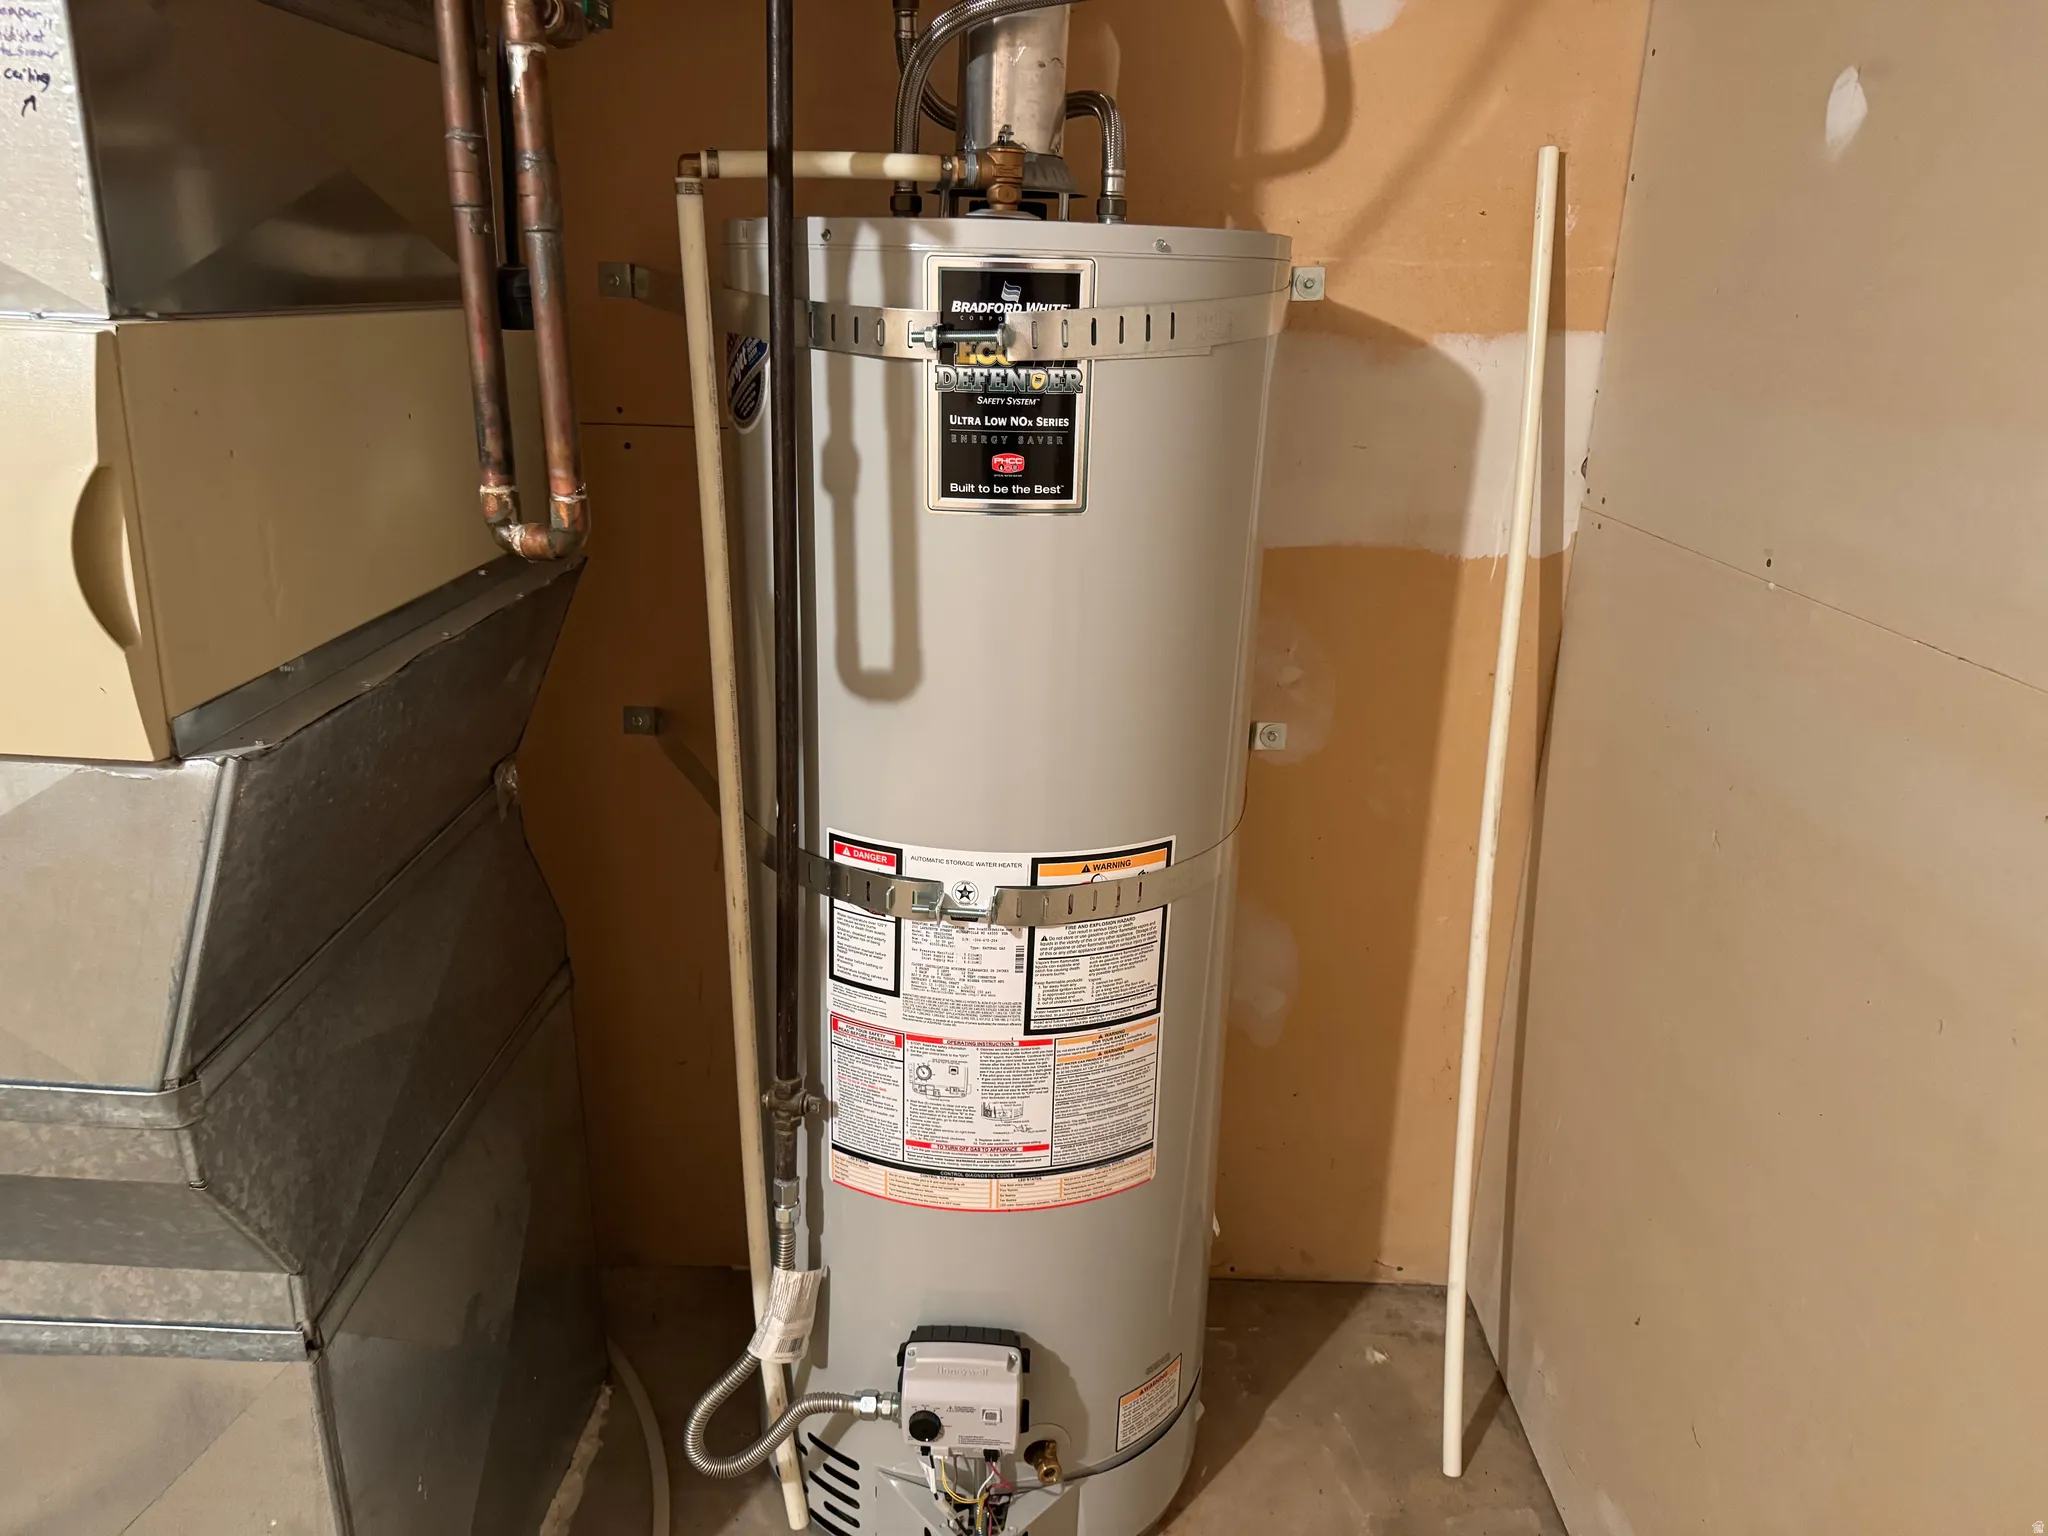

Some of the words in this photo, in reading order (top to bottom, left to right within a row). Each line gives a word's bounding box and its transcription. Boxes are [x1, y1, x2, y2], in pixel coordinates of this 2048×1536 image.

[951, 300, 1022, 314] BRADFORD
[1026, 302, 1068, 312] WHITE
[935, 364, 1083, 394] DEFENDER
[977, 396, 1005, 405] SAFETY
[949, 415, 981, 425] ULTRA
[985, 416, 1007, 426] LOW
[1036, 417, 1069, 427] SERIES
[951, 434, 1008, 444] ENERGY
[1018, 436, 1063, 445] SAVER
[950, 483, 975, 492] Built
[978, 484, 990, 493] to
[993, 484, 1008, 493] be
[1012, 485, 1031, 494] the
[853, 850, 888, 863] DANGER
[911, 855, 944, 864] AUTOMATIC
[1093, 860, 1131, 871] WARNING
[1104, 1029, 1126, 1037] WARNING
[868, 1036, 895, 1044] OPERATING
[1104, 1046, 1125, 1055] WARNING
